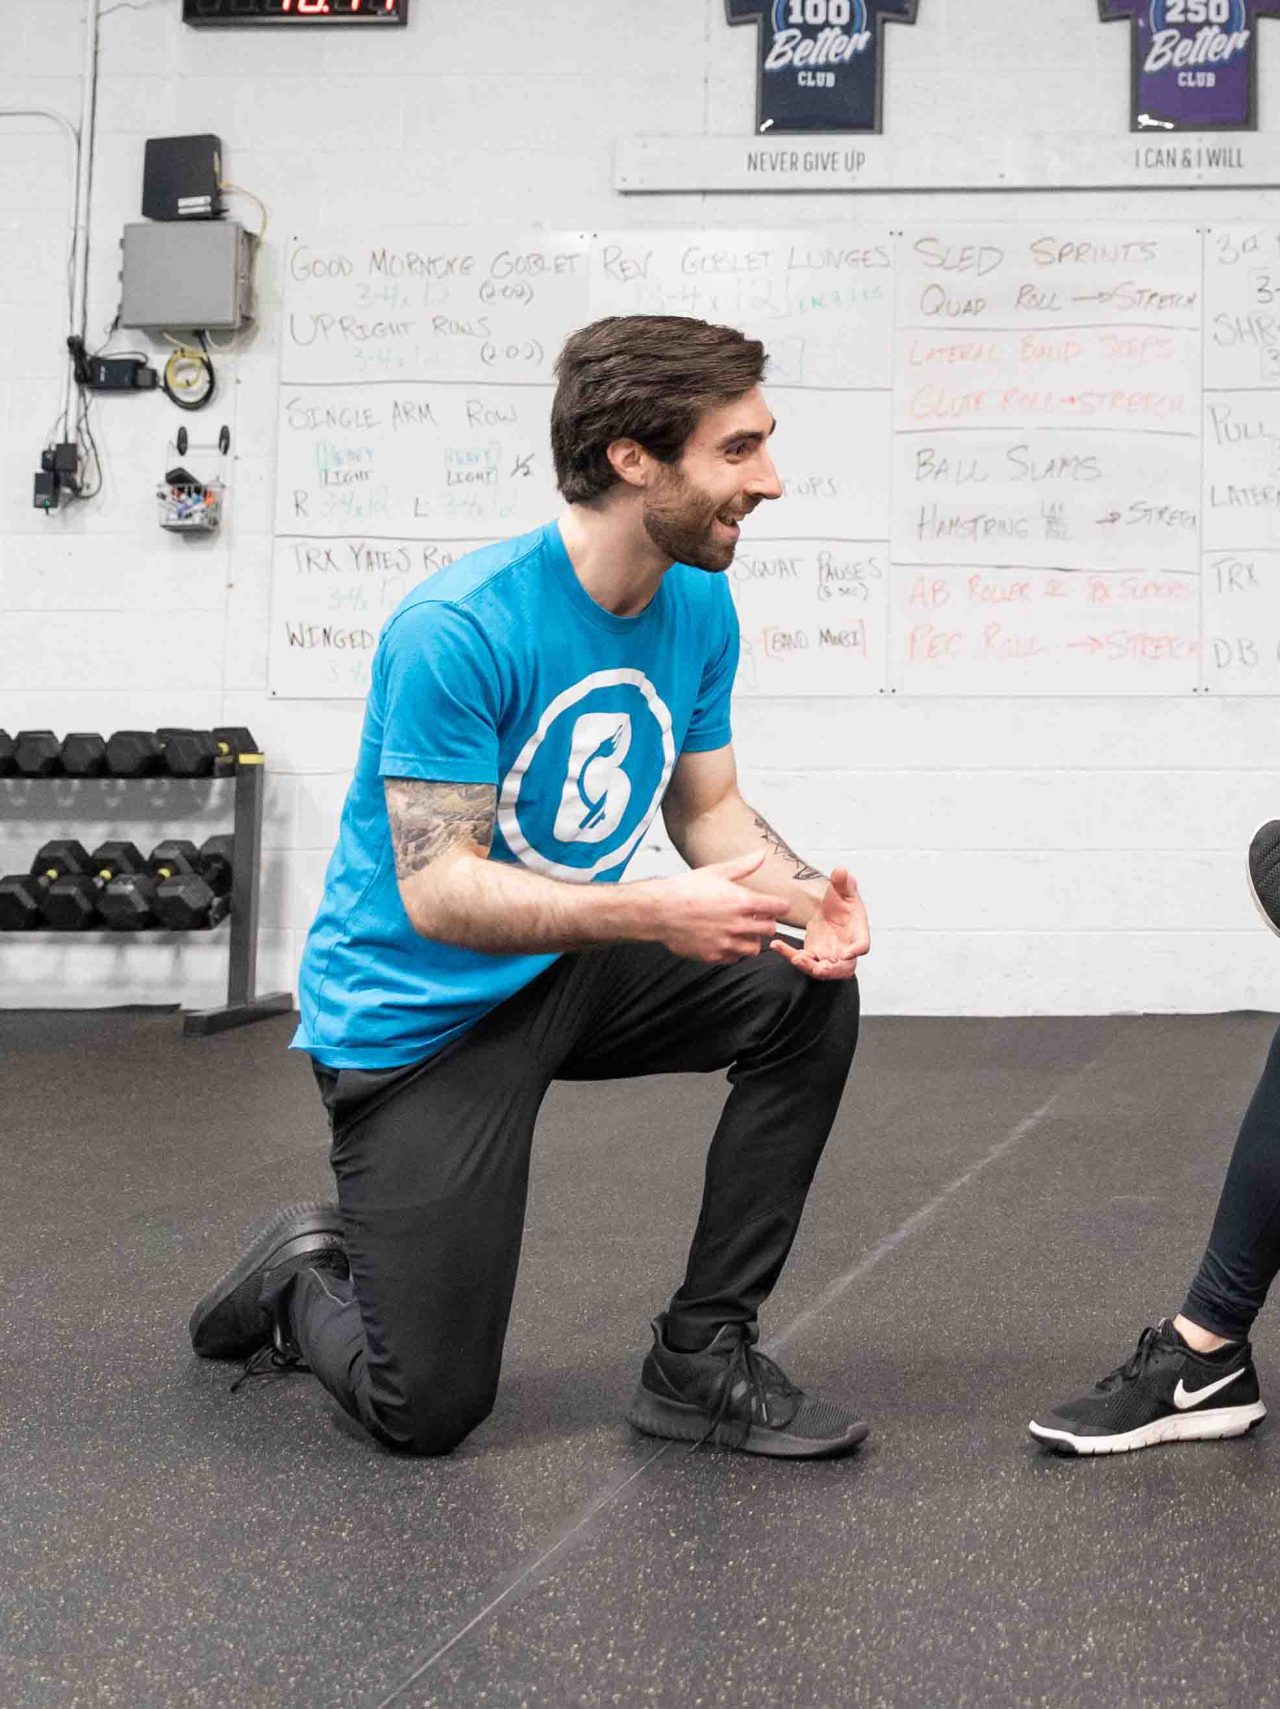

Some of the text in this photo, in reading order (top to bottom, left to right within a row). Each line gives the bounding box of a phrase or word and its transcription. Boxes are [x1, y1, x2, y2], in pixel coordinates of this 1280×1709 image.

[788, 0, 850, 25] 100
[1164, 0, 1229, 23] 250
[764, 26, 871, 70] Better
[1143, 25, 1250, 72] Better
[797, 70, 836, 88] CLUB
[1177, 71, 1216, 88] CLUB
[747, 150, 866, 172] NEVER GIVE UP
[1144, 147, 1177, 168] CAN
[1181, 148, 1192, 168] &
[1207, 147, 1244, 168] WILL
[290, 246, 353, 281] GOOD
[914, 236, 1158, 276] SLED SPRINTS
[920, 283, 986, 317] QUAD
[1015, 283, 1063, 311] ROLL
[915, 444, 1103, 484] BALL SLAMS
